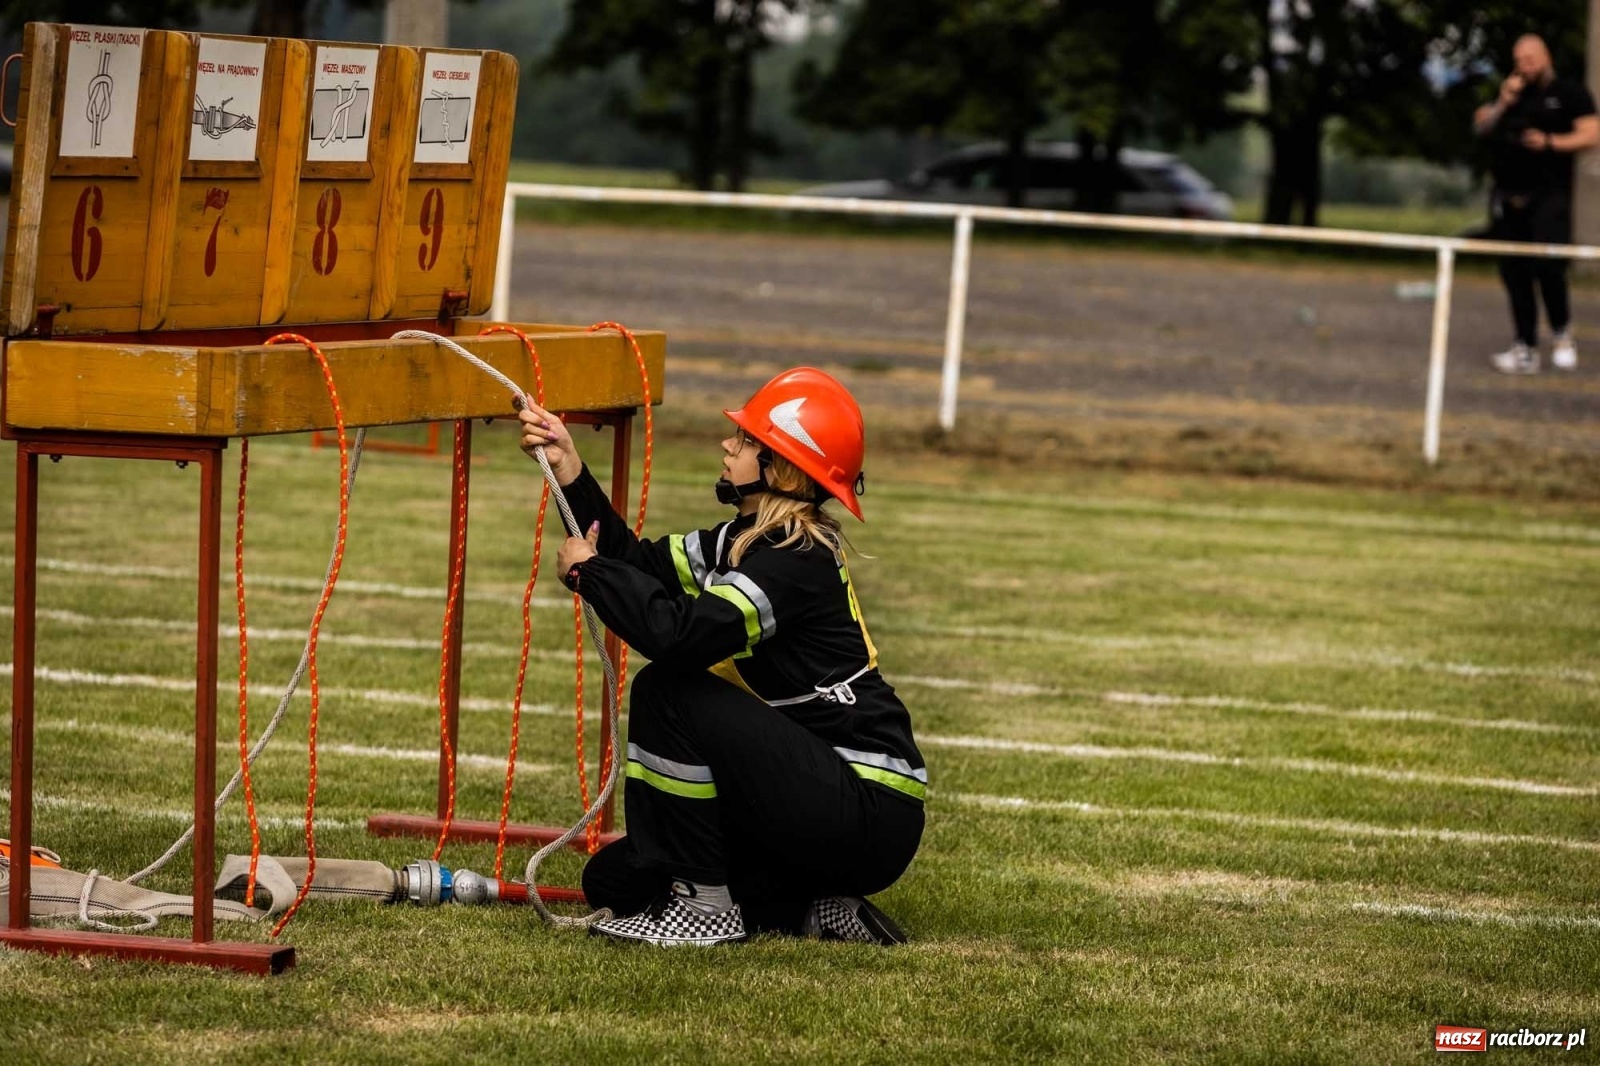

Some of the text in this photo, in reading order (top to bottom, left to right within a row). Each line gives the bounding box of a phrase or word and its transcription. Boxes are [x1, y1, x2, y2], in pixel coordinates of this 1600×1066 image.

[217, 64, 225, 74] NA
[227, 64, 260, 77] PRĄDOWNICY
[341, 64, 367, 75] MASZTOWY
[71, 185, 104, 283] 6
[204, 187, 230, 277] 7
[312, 187, 342, 276] 8
[418, 187, 445, 272] 9
